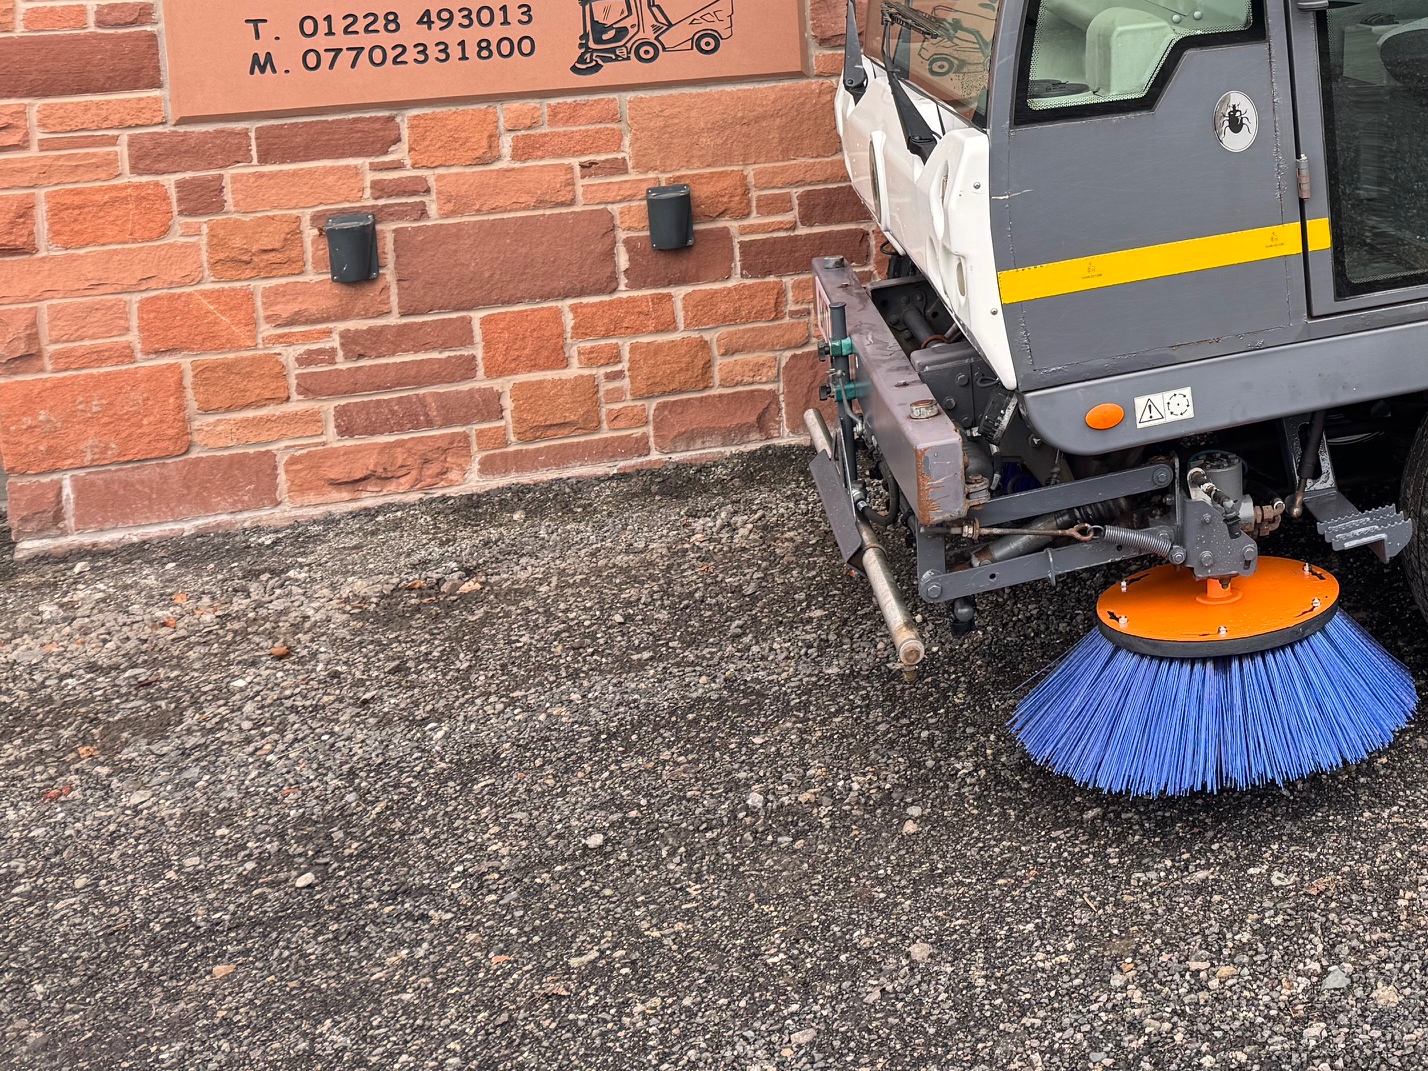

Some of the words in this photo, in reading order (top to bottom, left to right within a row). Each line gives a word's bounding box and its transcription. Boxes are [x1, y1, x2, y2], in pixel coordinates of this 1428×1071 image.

[244, 18, 281, 41] T.
[298, 8, 402, 39] 01228
[415, 3, 534, 32] 493013
[249, 51, 290, 76] M.
[301, 35, 537, 72] 07702331800
